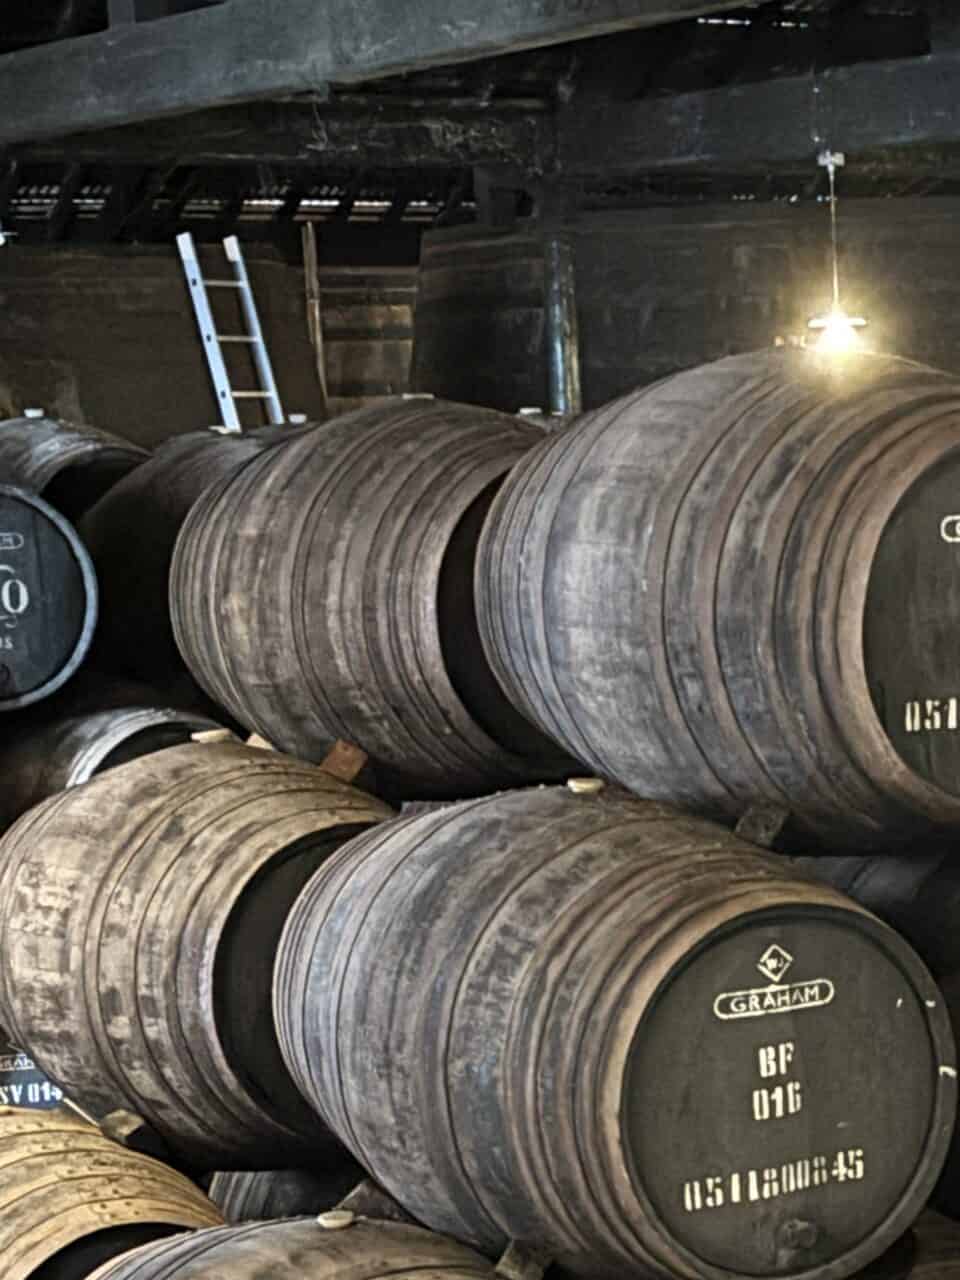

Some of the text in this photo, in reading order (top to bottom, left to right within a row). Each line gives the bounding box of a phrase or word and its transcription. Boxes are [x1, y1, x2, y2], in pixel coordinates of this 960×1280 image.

[730, 984, 820, 1014] GRAHAM
[758, 1042, 795, 1078] BF
[752, 1081, 801, 1121] 016
[684, 1149, 864, 1212] 0511800845
